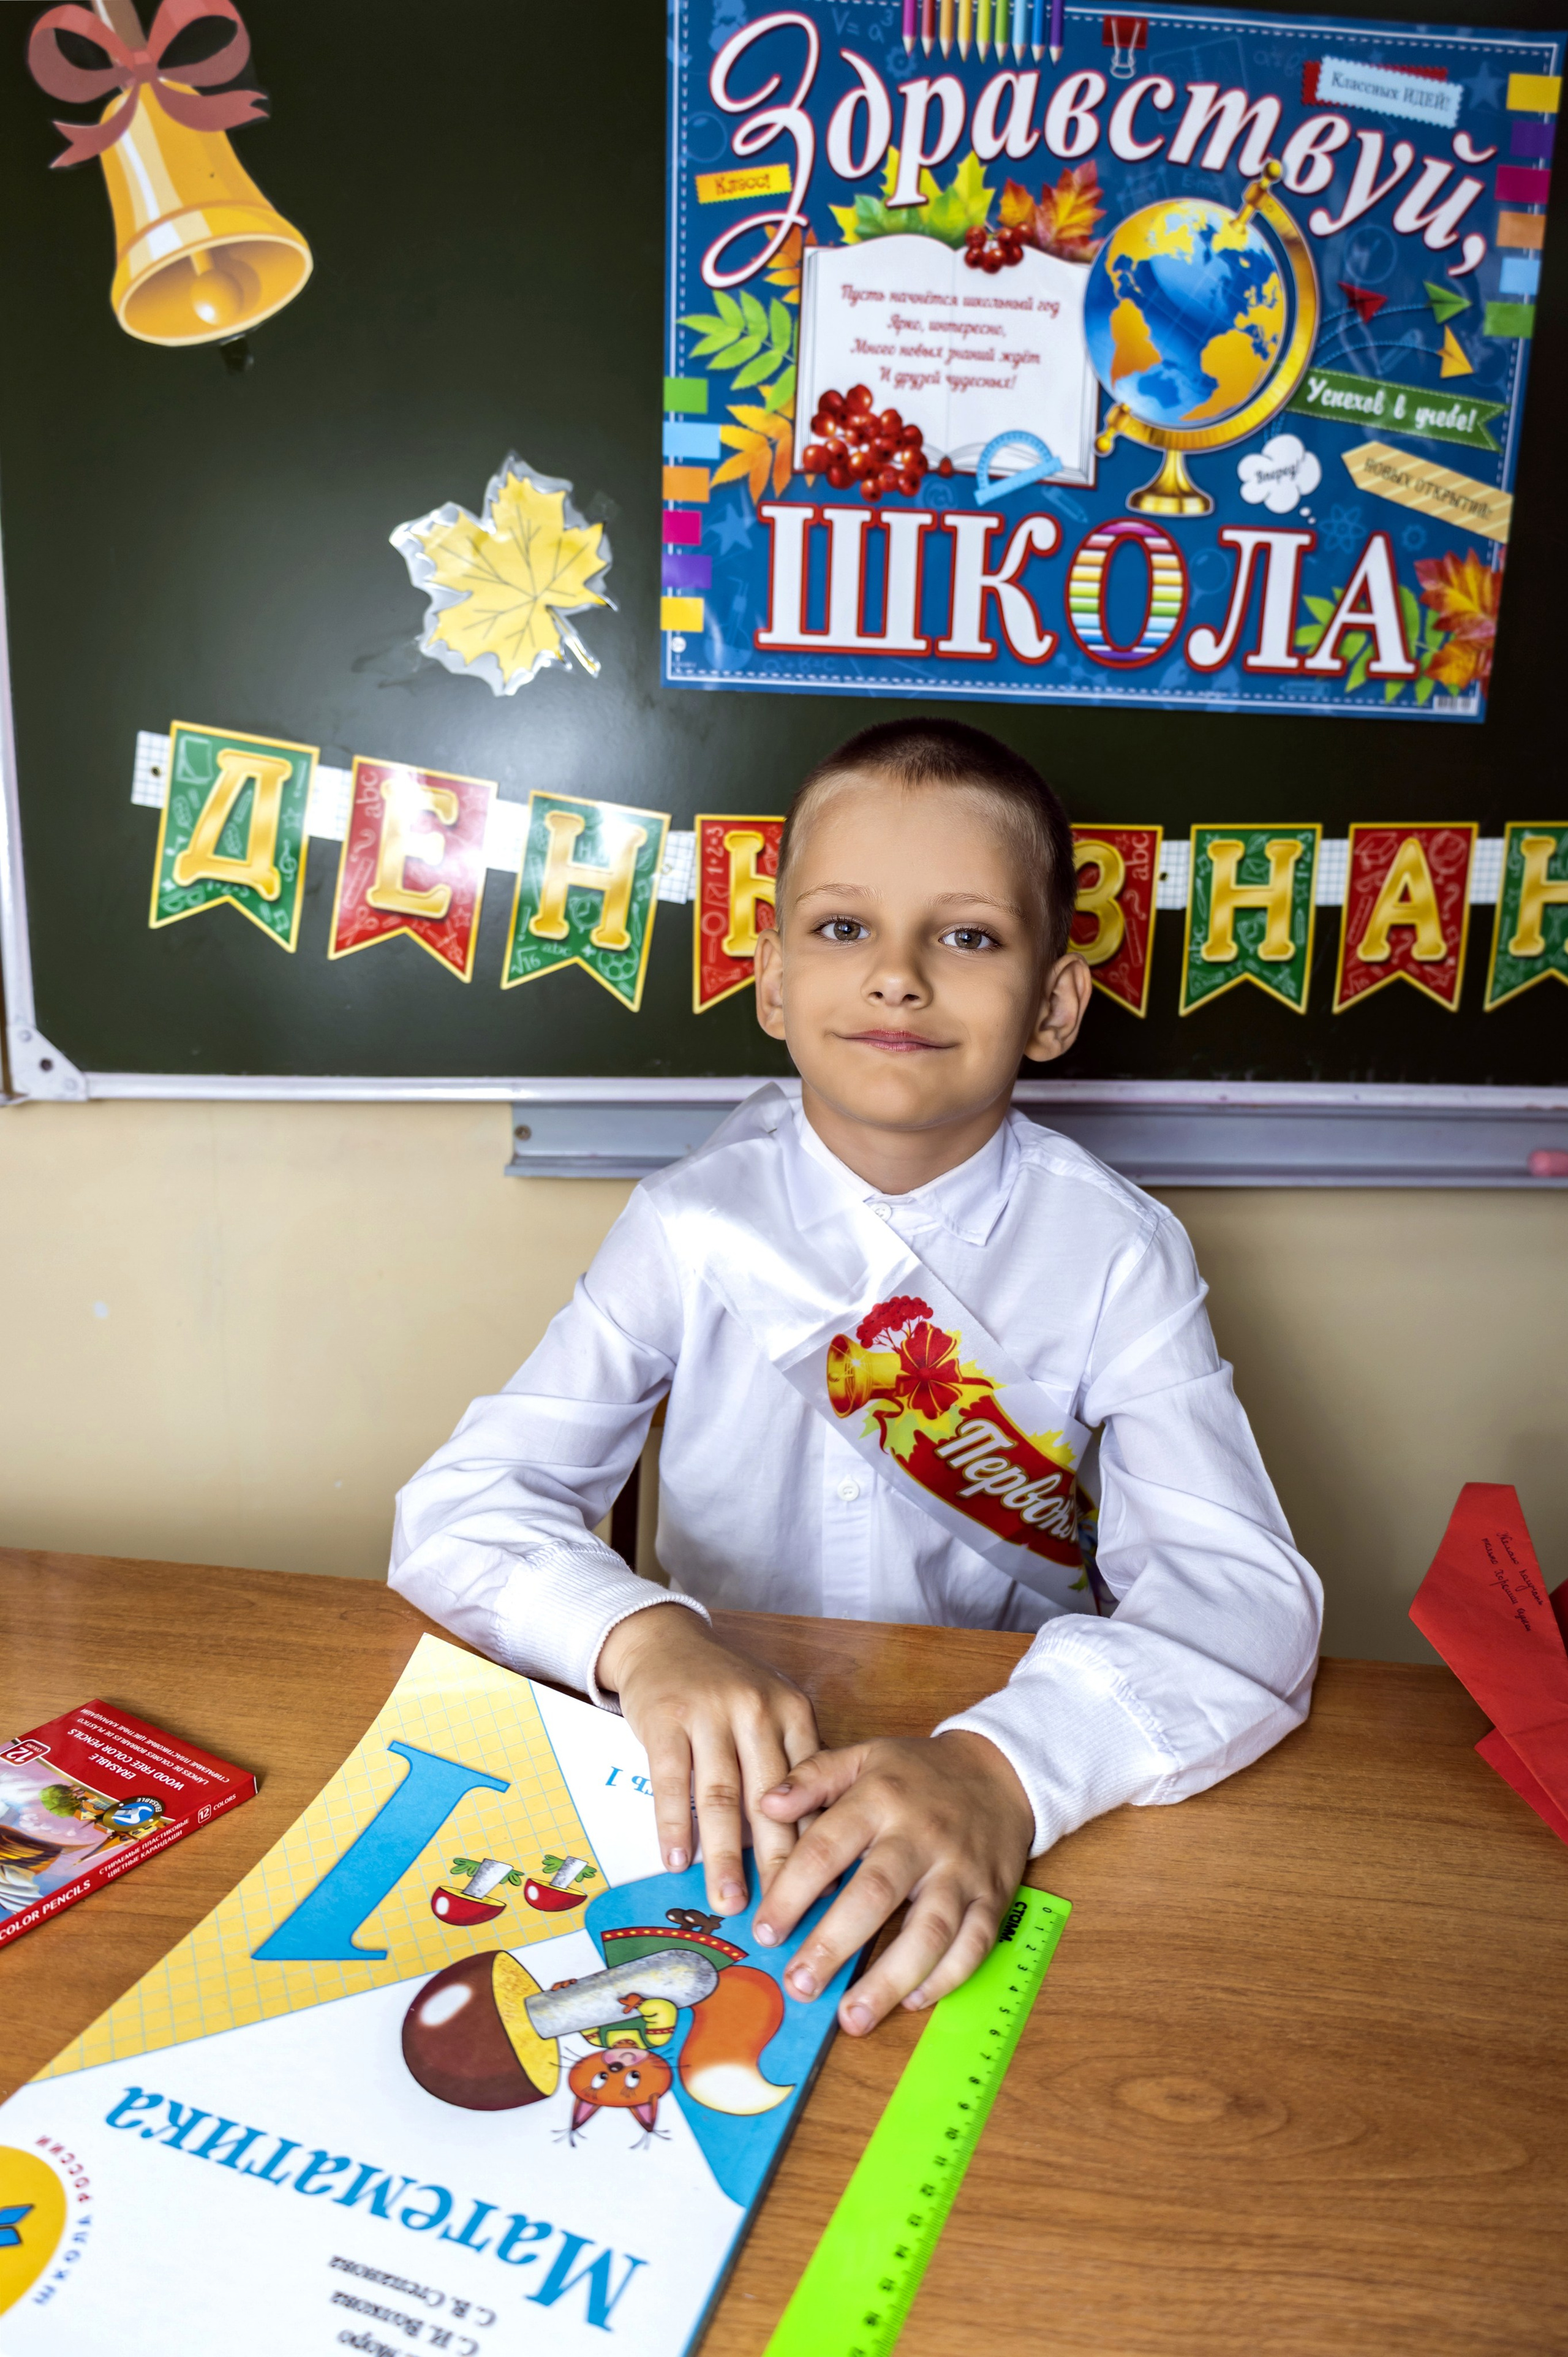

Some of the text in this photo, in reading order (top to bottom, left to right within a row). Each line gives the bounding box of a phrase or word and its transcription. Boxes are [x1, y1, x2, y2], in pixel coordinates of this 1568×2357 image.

[1332, 70, 1399, 100] Классных
[701, 12, 1498, 289] Здравствуй,
[714, 173, 771, 196] Класс!
[841, 284, 884, 307] Пусть
[963, 296, 1033, 311] школьный
[1037, 300, 1060, 319] год
[929, 322, 1006, 340] интересно,
[850, 338, 895, 355] Много
[899, 343, 942, 357] новых
[944, 347, 995, 366] знаний
[880, 366, 1017, 392] И друзей чудесных!
[1307, 376, 1478, 433] Успехов в учебе!
[754, 502, 1420, 681] ШКОЛА
[6, 1746, 34, 1763] 12
[80, 1708, 230, 1784] СТИРАЕМЫЕ ПЛАСТИКОВЫЕ ЦВЕТНЫЕ КАРАНДАШИ
[112, 1735, 148, 1755] BORRABLES
[145, 1750, 175, 1768] COLORES
[67, 1728, 185, 1791] WOOD FREE COLOR PENCILS
[88, 1752, 137, 1780] ERASABLE
[136, 1796, 162, 1813] ERASABLE
[199, 1793, 237, 1821] 12 COLORS
[99, 1817, 190, 1875] СТИРАЕМЫЕ ПЛАСТИКОВЫЕ
[107, 1829, 183, 1878] ЦВЕТНЫЕ КАРАНДАШИ
[251, 1739, 510, 1960] 1
[0, 1879, 91, 1940] COLOR PENCILS
[1025, 1943, 1036, 1952] 2
[999, 2006, 1011, 2015] 5
[989, 2029, 1001, 2037] 6
[980, 2051, 992, 2060] 7
[968, 2076, 981, 2086] 8
[957, 2100, 970, 2110] 9
[944, 2126, 960, 2141] 10
[933, 2154, 949, 2167] 11
[919, 2182, 937, 2198] 12
[32, 2135, 92, 2306] ШКОЛА РОССИИ
[105, 2086, 649, 2332] Математика
[329, 2255, 446, 2308] Степанова
[330, 2290, 424, 2337] Волкова
[475, 2306, 497, 2327] С.
